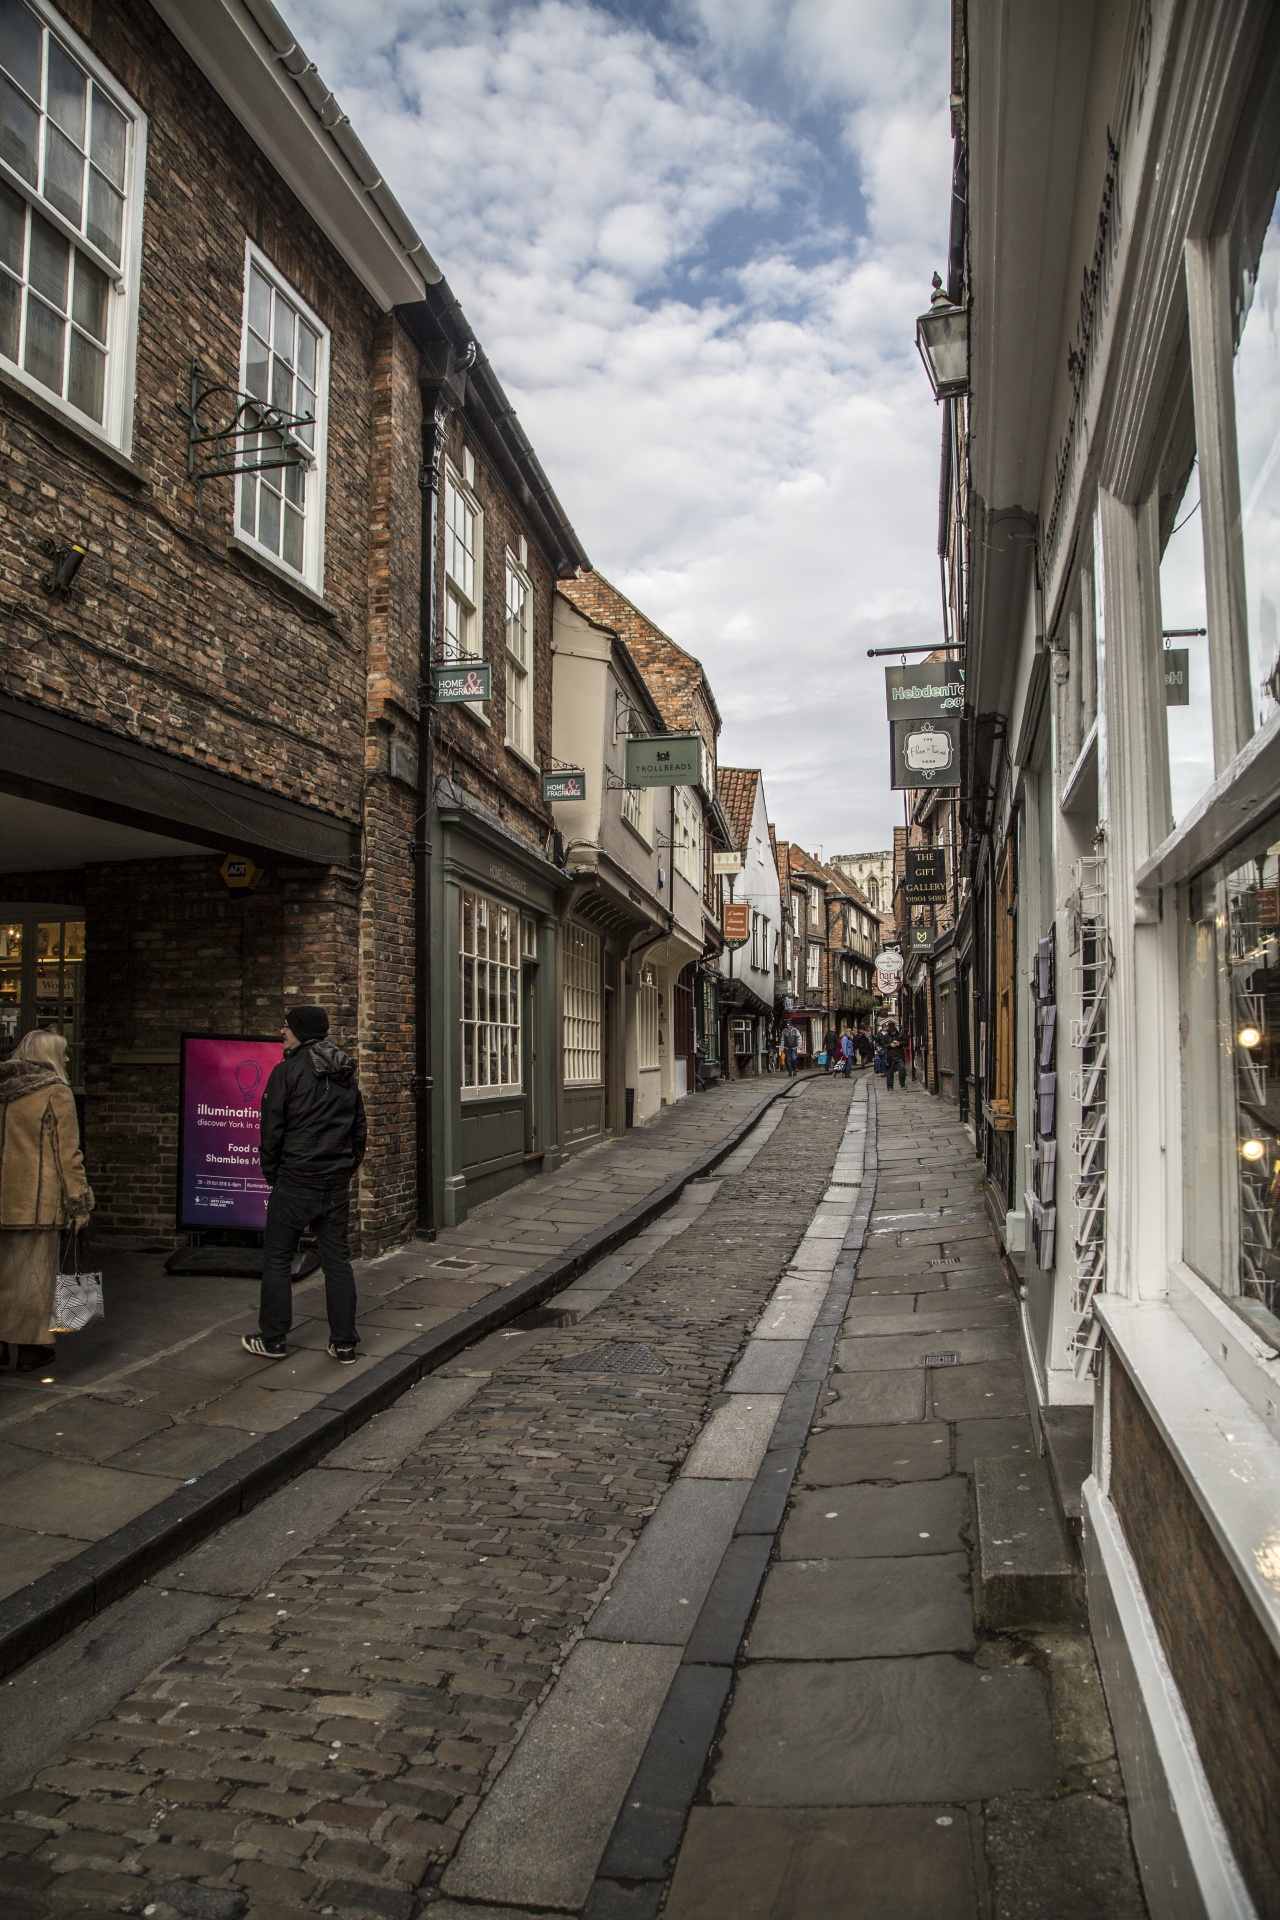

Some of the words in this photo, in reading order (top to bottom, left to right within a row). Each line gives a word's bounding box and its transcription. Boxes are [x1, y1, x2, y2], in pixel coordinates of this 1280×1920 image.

[438, 679, 464, 688] HOME
[463, 671, 483, 695] &
[438, 686, 484, 696] FRAGRANCE
[940, 698, 964, 708] .co
[636, 763, 692, 772] TROLLBEADS
[565, 778, 580, 796] &
[228, 865, 246, 874] ADT
[490, 863, 502, 882] HOME
[915, 868, 935, 876] GIFT
[906, 883, 946, 892] GALLERY
[197, 1118, 227, 1127] discover
[228, 1144, 250, 1152] Food
[206, 1154, 249, 1165] Shambles
